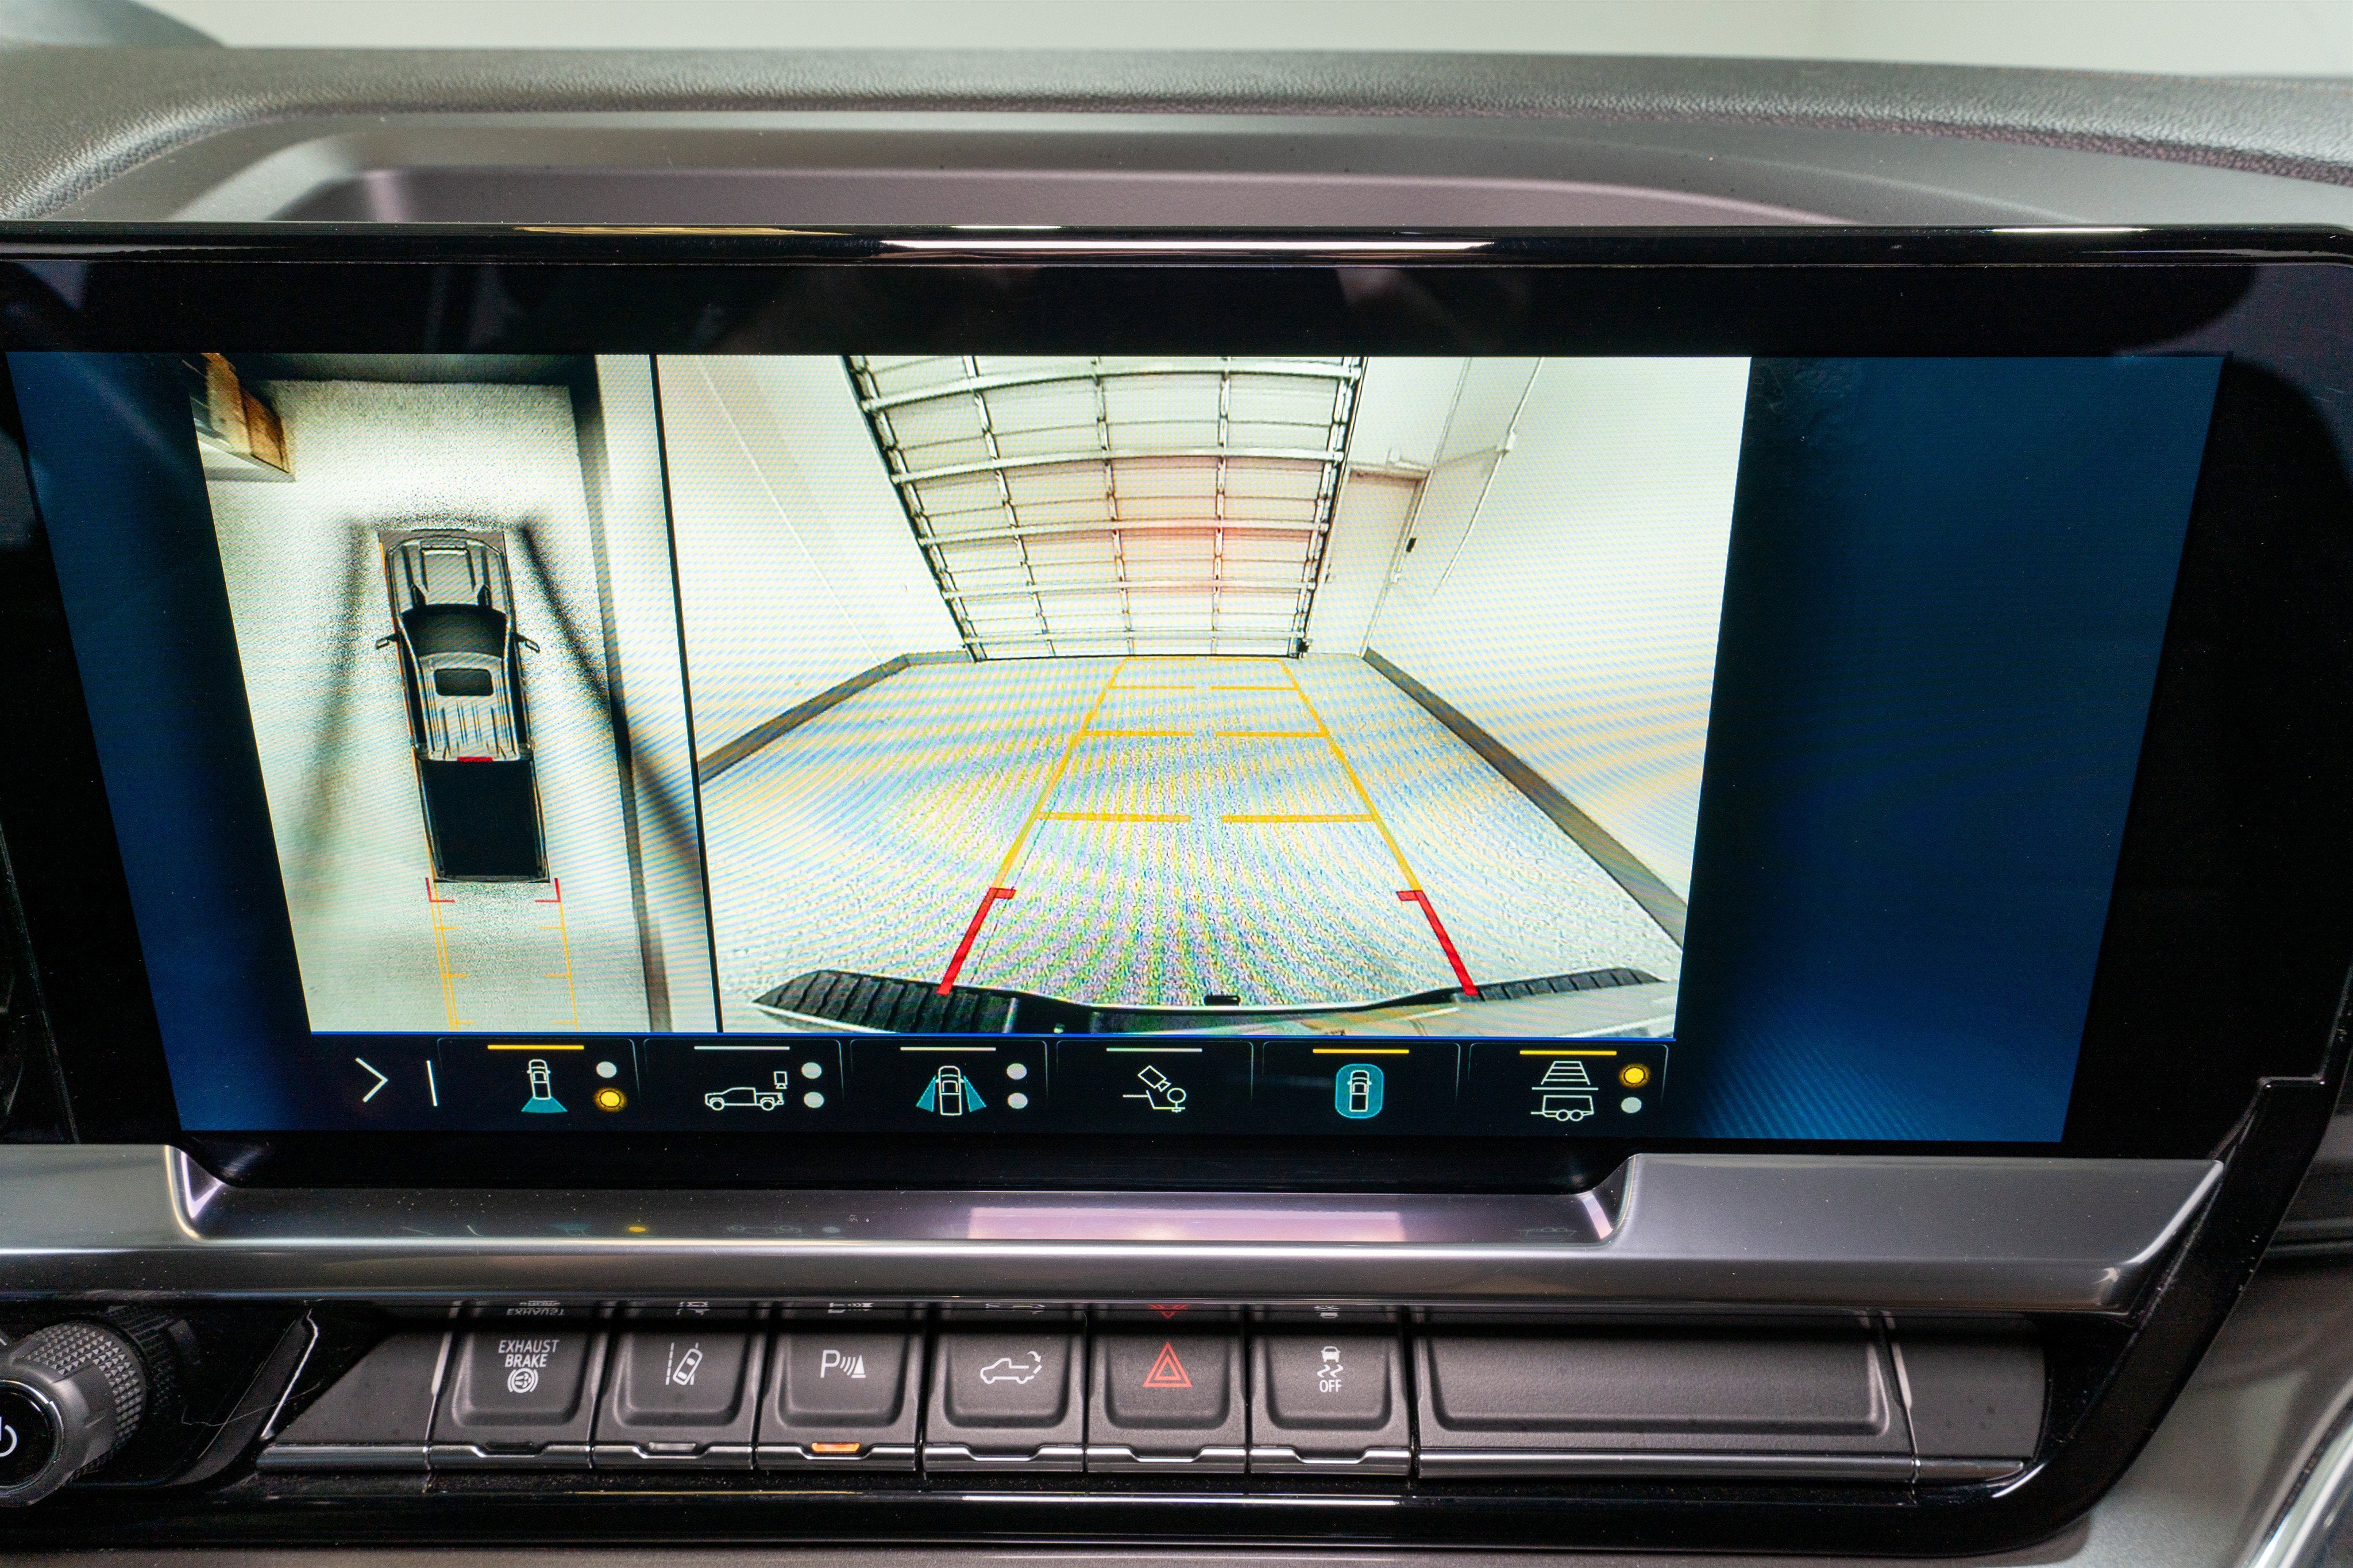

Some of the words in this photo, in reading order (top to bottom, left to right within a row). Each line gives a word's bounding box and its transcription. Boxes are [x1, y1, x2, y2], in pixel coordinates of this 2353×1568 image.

[497, 1339, 560, 1354] EXHAUST
[504, 1353, 549, 1368] BRAKE
[820, 1349, 841, 1378] P
[1319, 1379, 1343, 1393] OFF
